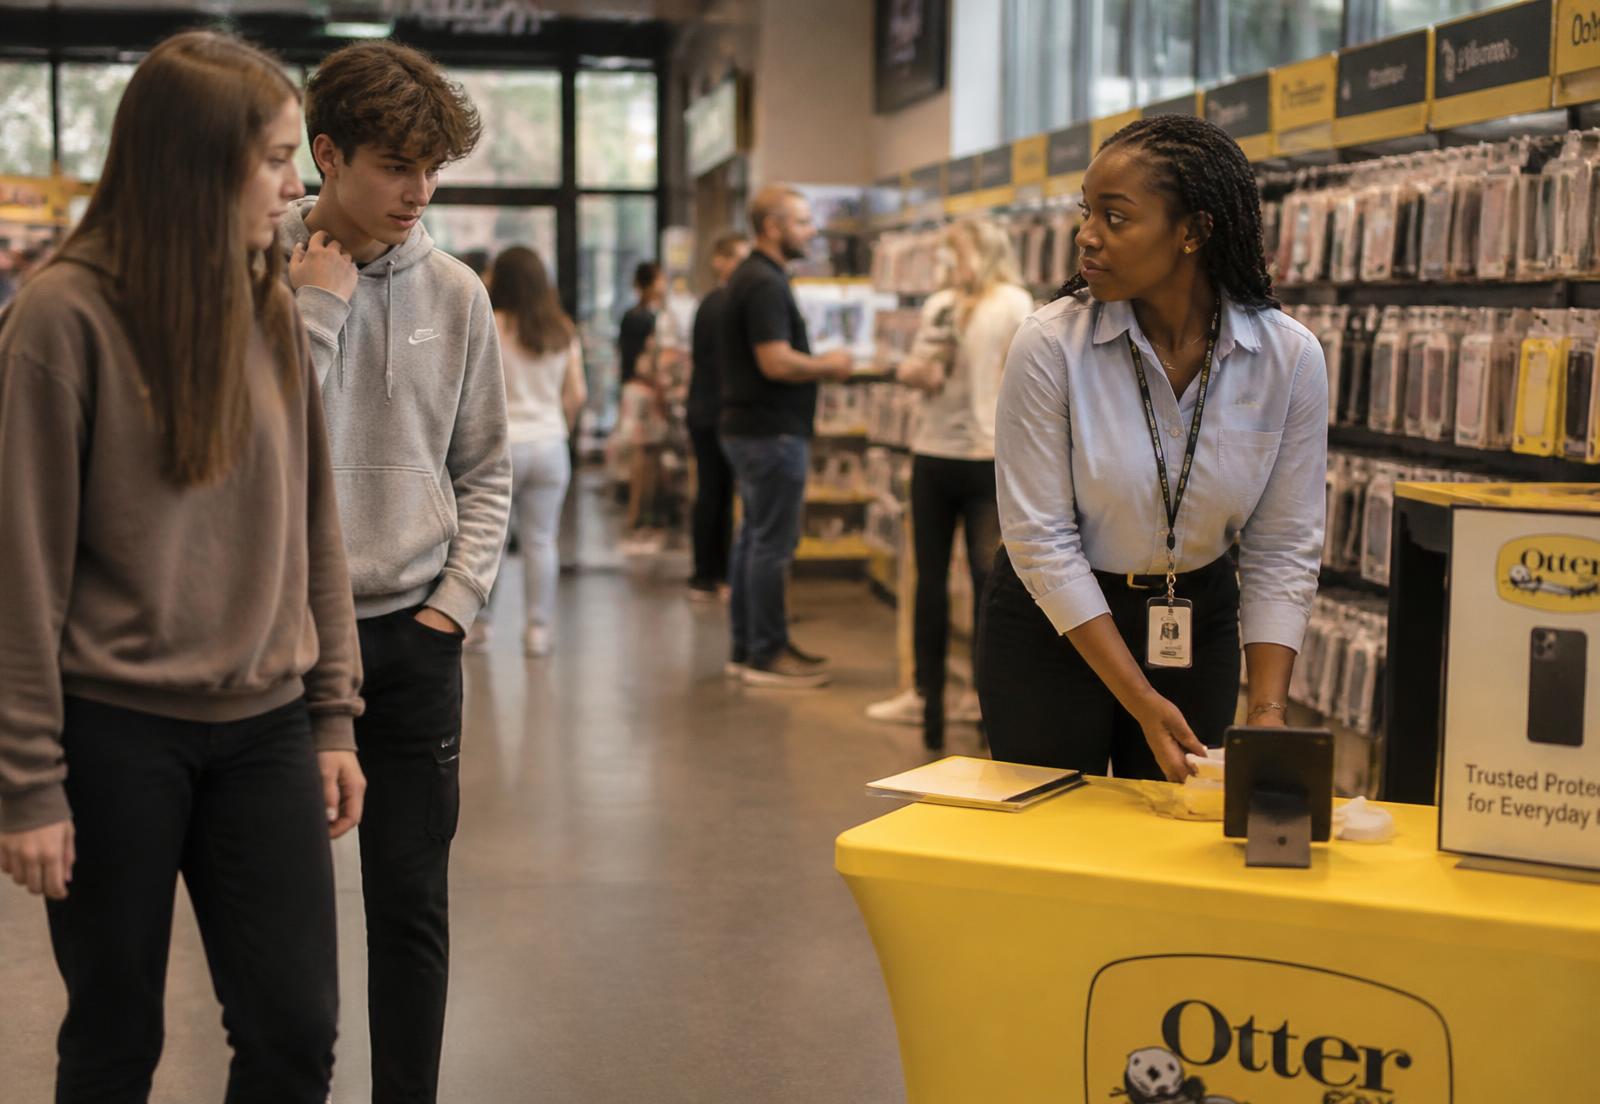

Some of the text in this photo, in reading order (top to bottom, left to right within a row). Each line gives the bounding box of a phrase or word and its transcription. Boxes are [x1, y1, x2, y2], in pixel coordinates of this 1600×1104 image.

[1465, 763, 1538, 791] Trusted
[1467, 792, 1495, 814] for
[1500, 795, 1591, 831] Everyday
[1161, 1000, 1412, 1094] Otter
